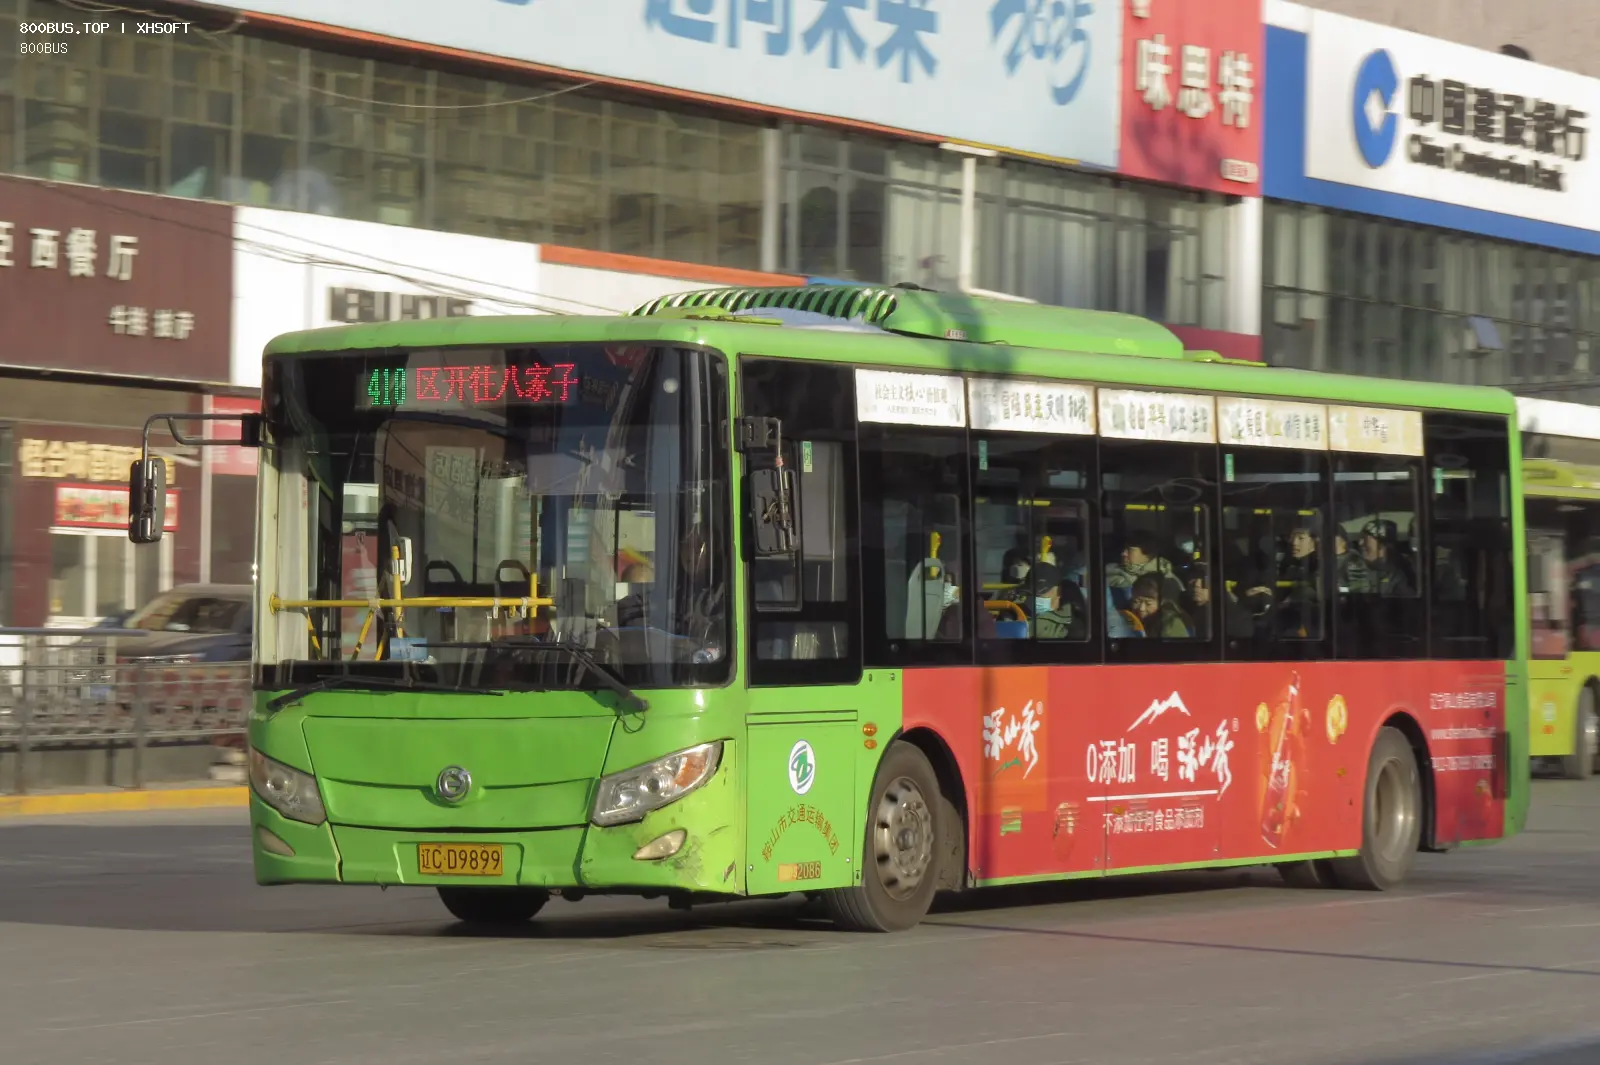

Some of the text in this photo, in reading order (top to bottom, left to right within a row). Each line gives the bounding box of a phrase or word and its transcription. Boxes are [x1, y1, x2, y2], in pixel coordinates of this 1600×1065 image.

[367, 368, 406, 405] 410
[415, 362, 579, 403] 区开往八家子
